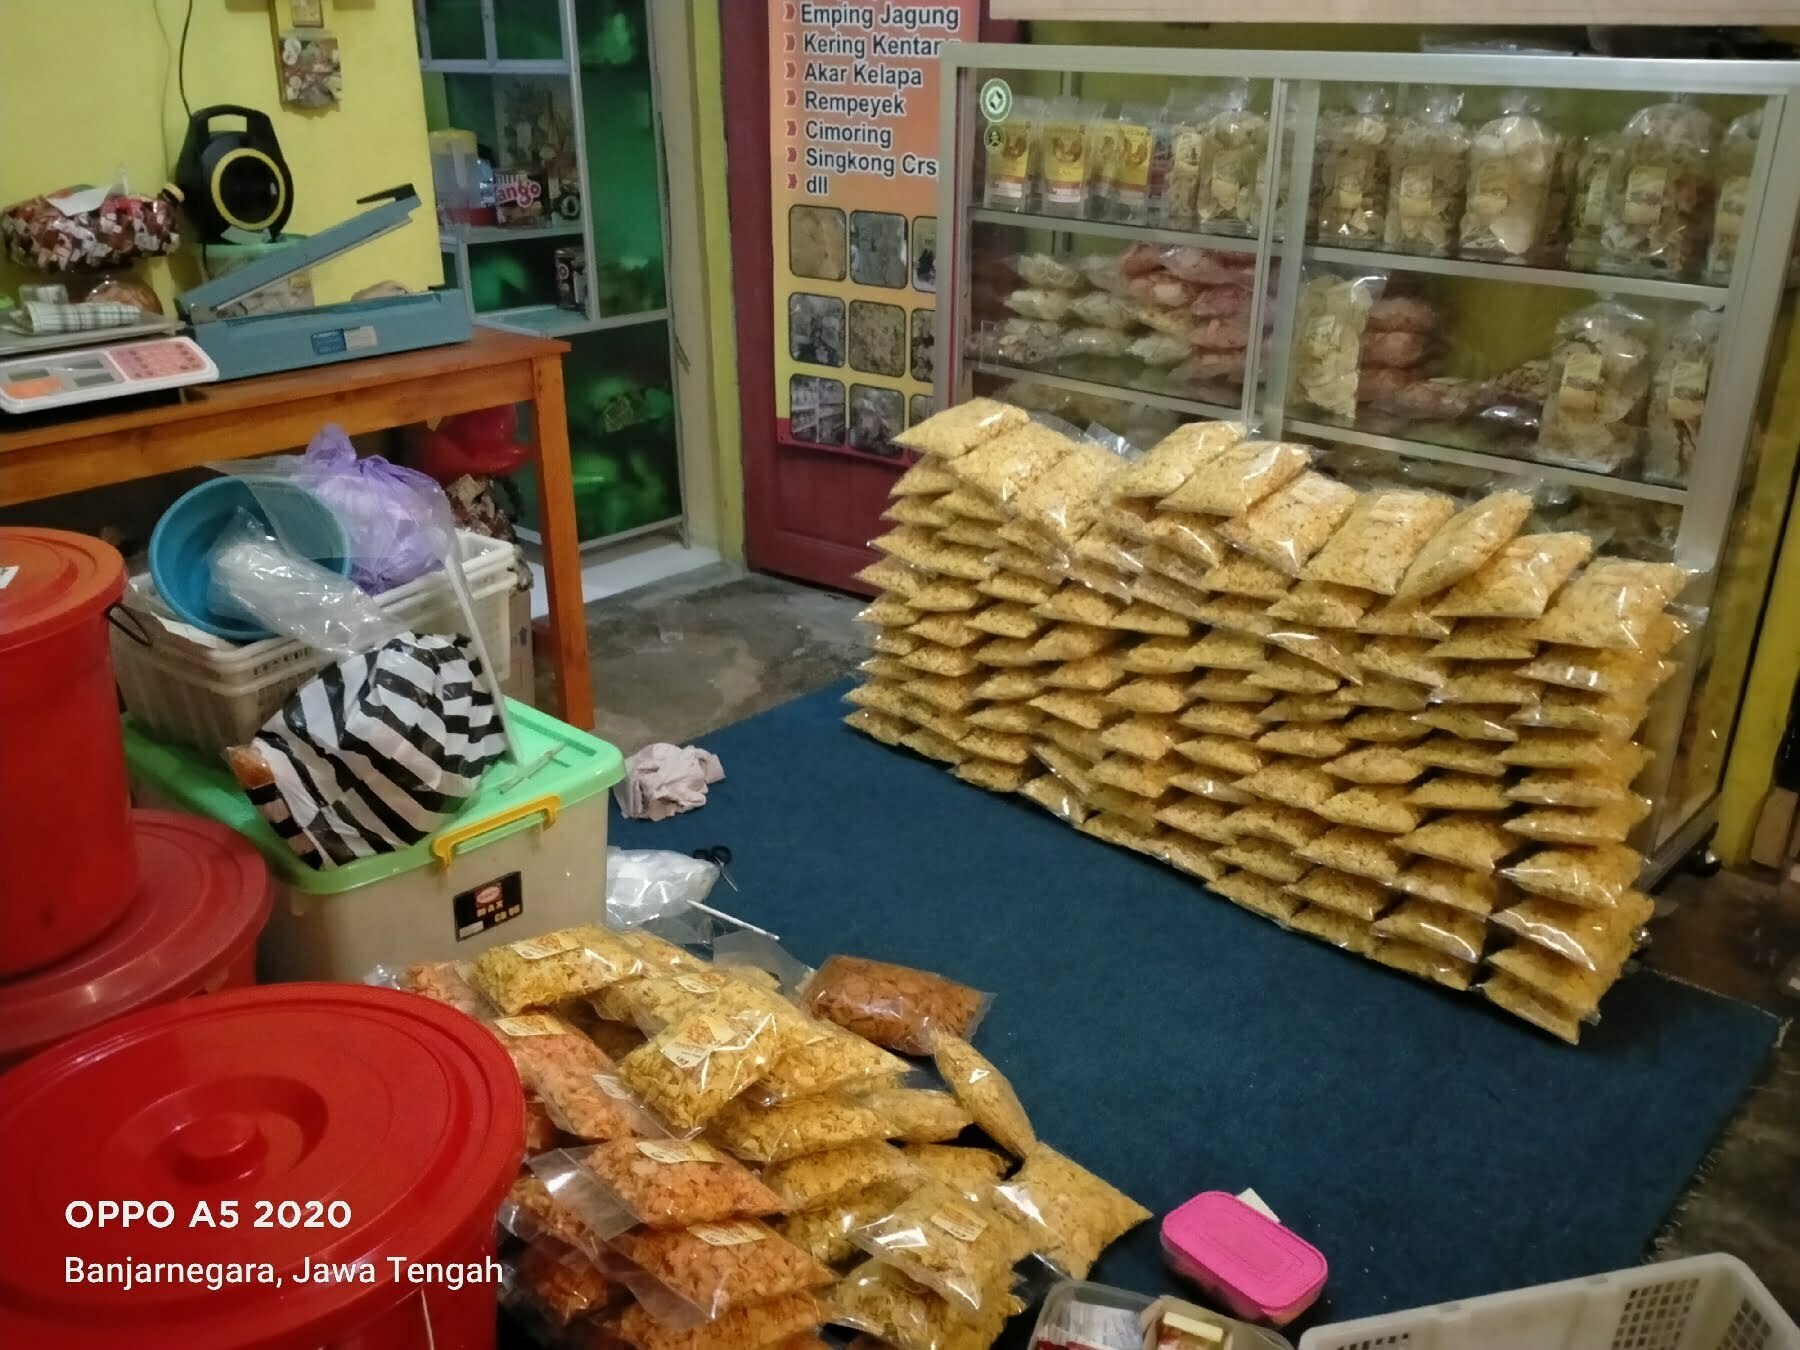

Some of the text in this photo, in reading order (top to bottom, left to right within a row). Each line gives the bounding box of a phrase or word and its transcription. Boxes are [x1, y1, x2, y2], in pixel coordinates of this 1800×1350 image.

[801, 4, 959, 30] Emping Jagung
[804, 33, 865, 59] Kering
[804, 63, 922, 89] Akar Kelapa
[804, 91, 905, 118] Rempeyek
[805, 121, 892, 148] Cimoring
[806, 148, 937, 177] Singkong Crs
[495, 182, 540, 205] ango
[806, 176, 828, 194] dll
